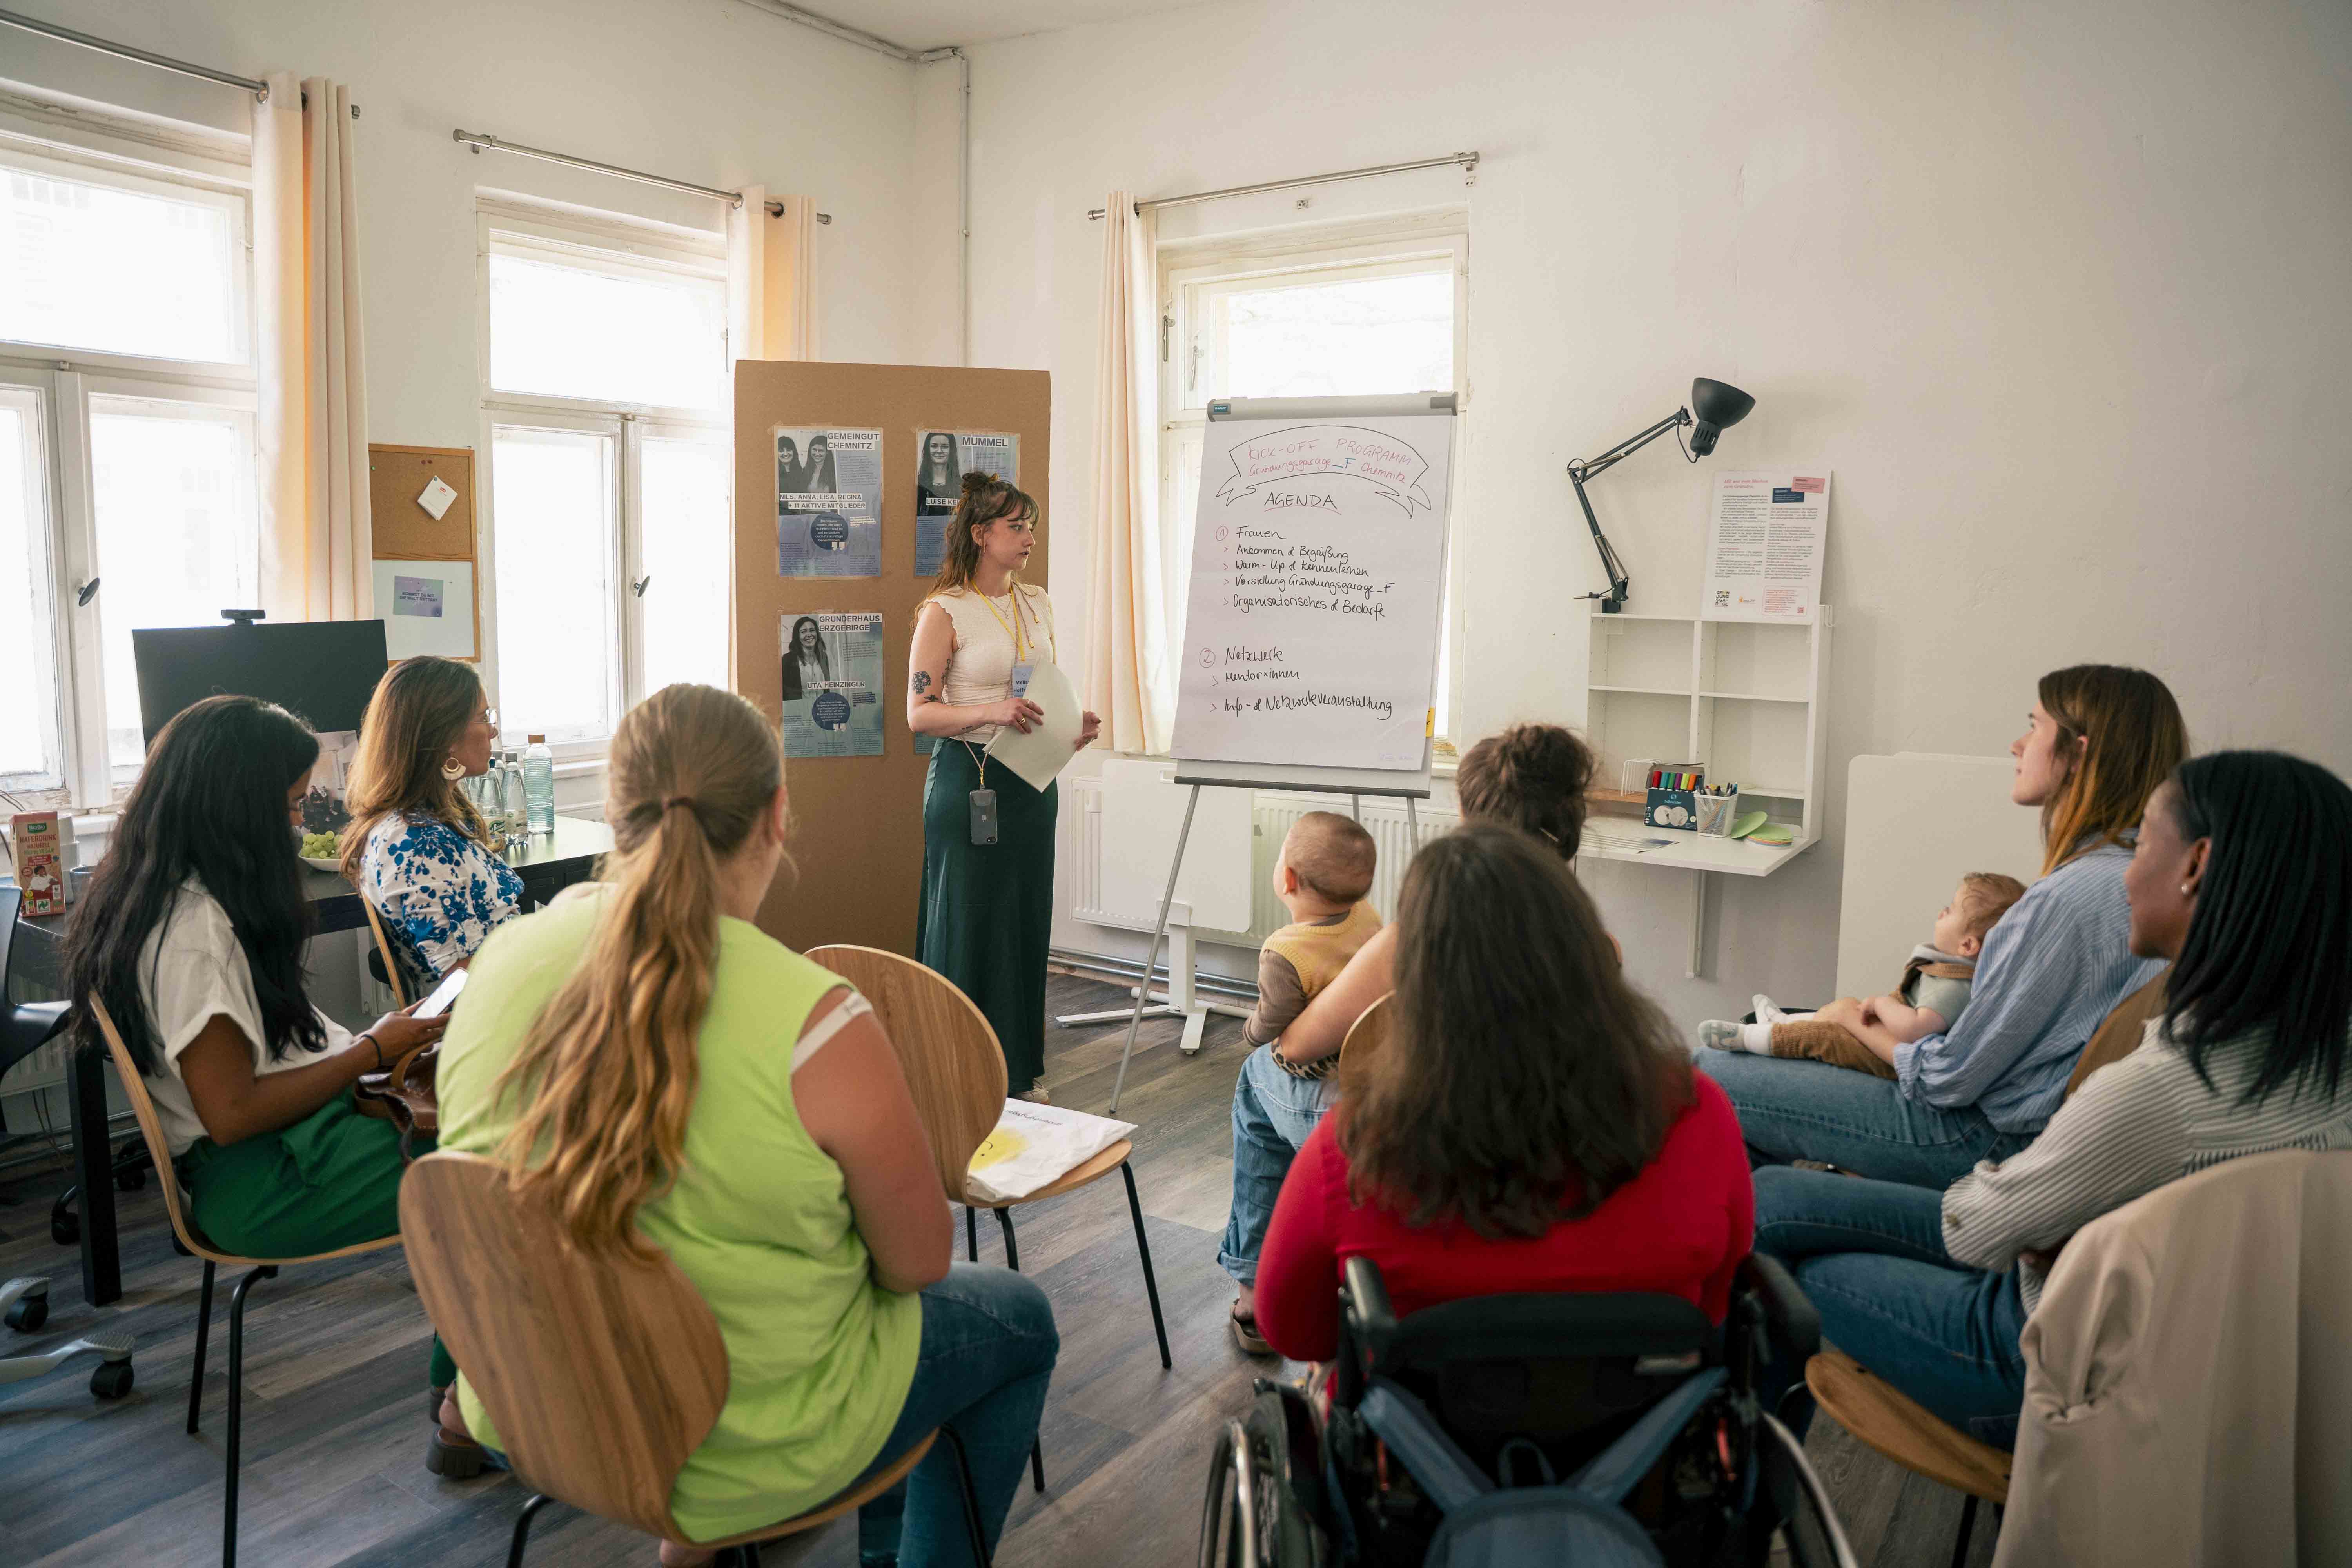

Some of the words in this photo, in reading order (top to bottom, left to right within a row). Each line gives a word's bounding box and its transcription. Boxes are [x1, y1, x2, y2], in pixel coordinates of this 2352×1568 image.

[962, 437, 1008, 447] MUMMEL
[1248, 439, 1319, 460] KICK-OFF
[1336, 438, 1412, 465] PROGRAMM
[1361, 462, 1405, 484] Chemnitz
[1264, 492, 1337, 509] AGENDA
[1236, 525, 1286, 539] Frauen
[1236, 544, 1284, 557] Ankommen
[1299, 545, 1349, 564] Begrüßung
[1236, 574, 1286, 592] Vorstellung
[1233, 594, 1327, 613] Organisatorisches
[1343, 601, 1386, 621] Bedarfe
[1225, 646, 1283, 665] Netzwerk
[1265, 690, 1392, 720] Netzwerkveranstaltung
[20, 834, 56, 844] HAFERDRINK
